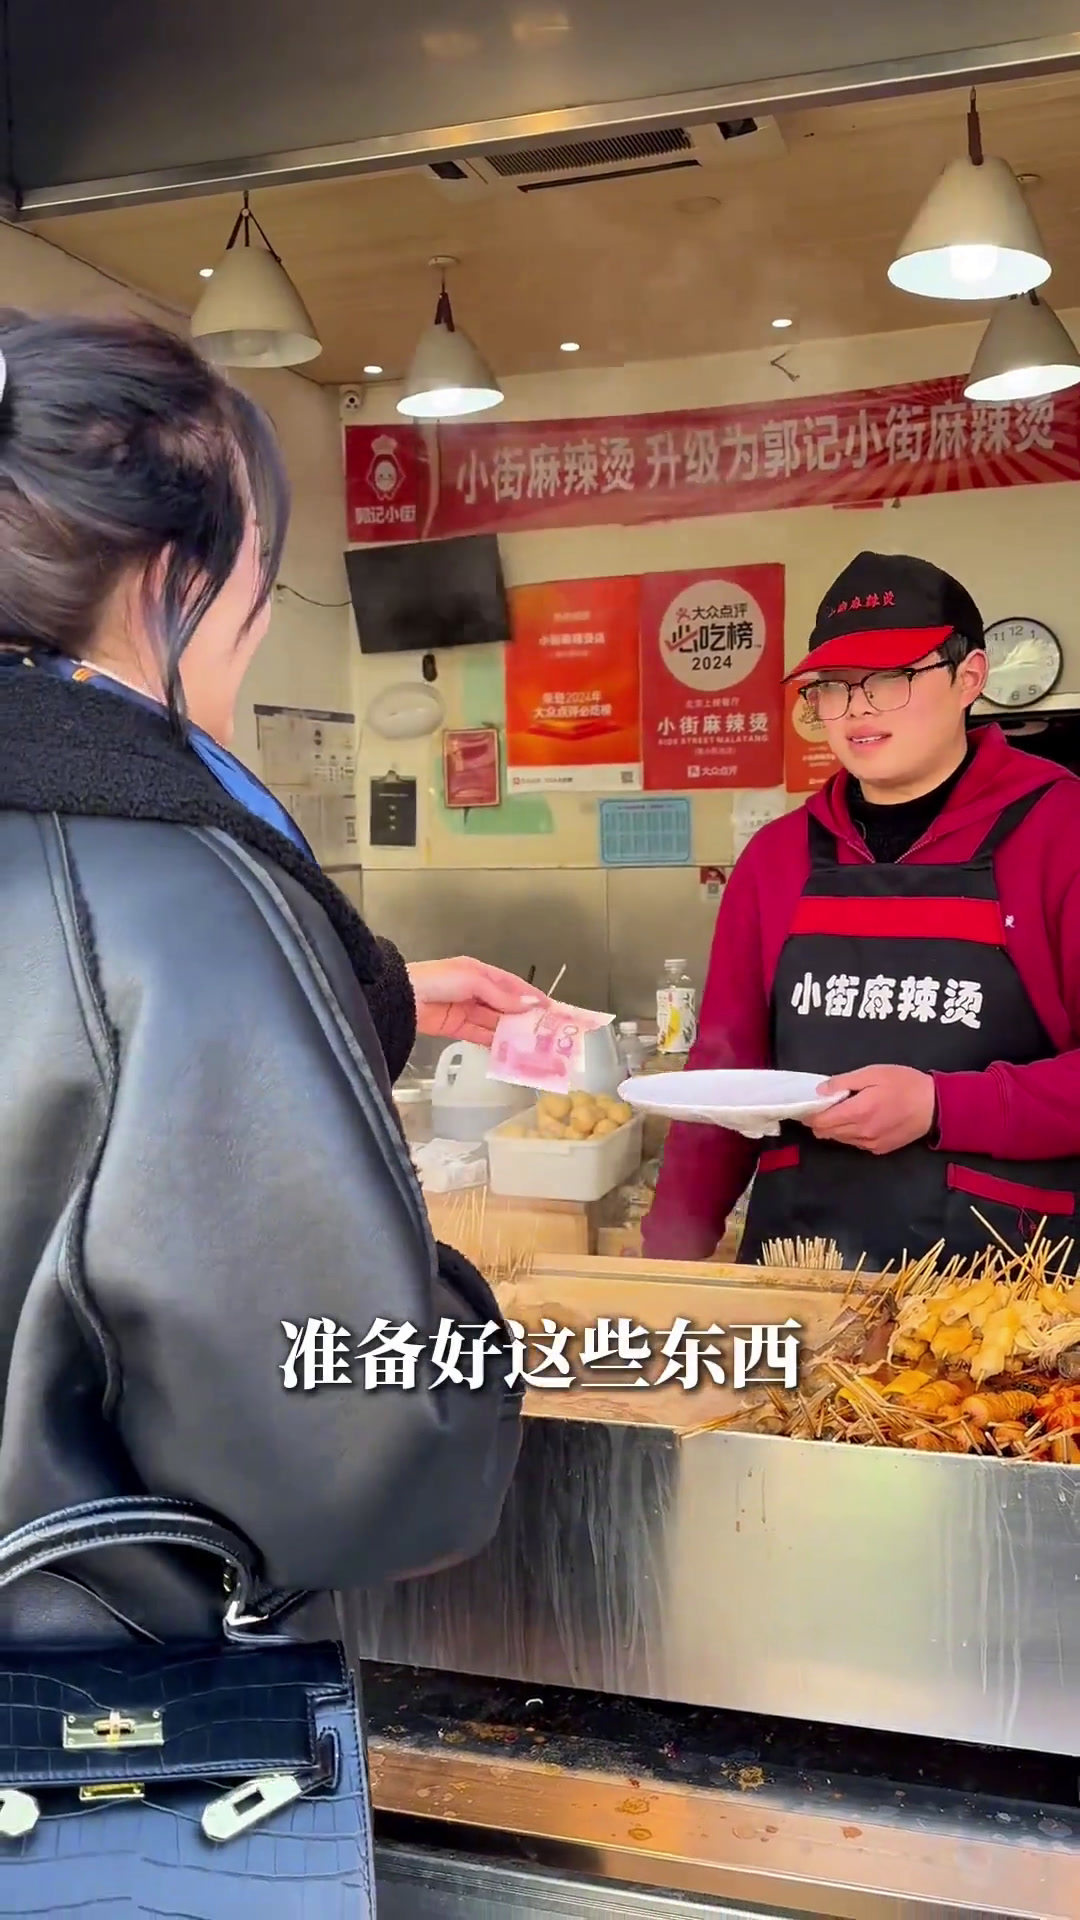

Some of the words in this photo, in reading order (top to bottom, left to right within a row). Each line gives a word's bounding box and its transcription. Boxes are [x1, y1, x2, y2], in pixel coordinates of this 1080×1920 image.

[456, 437, 635, 505] 小街麻辣烫
[646, 399, 1056, 490] 升级为郭记小街麻辣烫
[692, 602, 748, 620] 大众点评
[664, 620, 754, 653] 必吃榜
[1009, 625, 1024, 636] 12
[691, 655, 733, 671] 2024
[1011, 691, 1020, 701] 6
[1028, 685, 1037, 695] 5
[656, 712, 769, 736] 小街麻辣烫
[790, 971, 984, 1030] 小街麻辣烫
